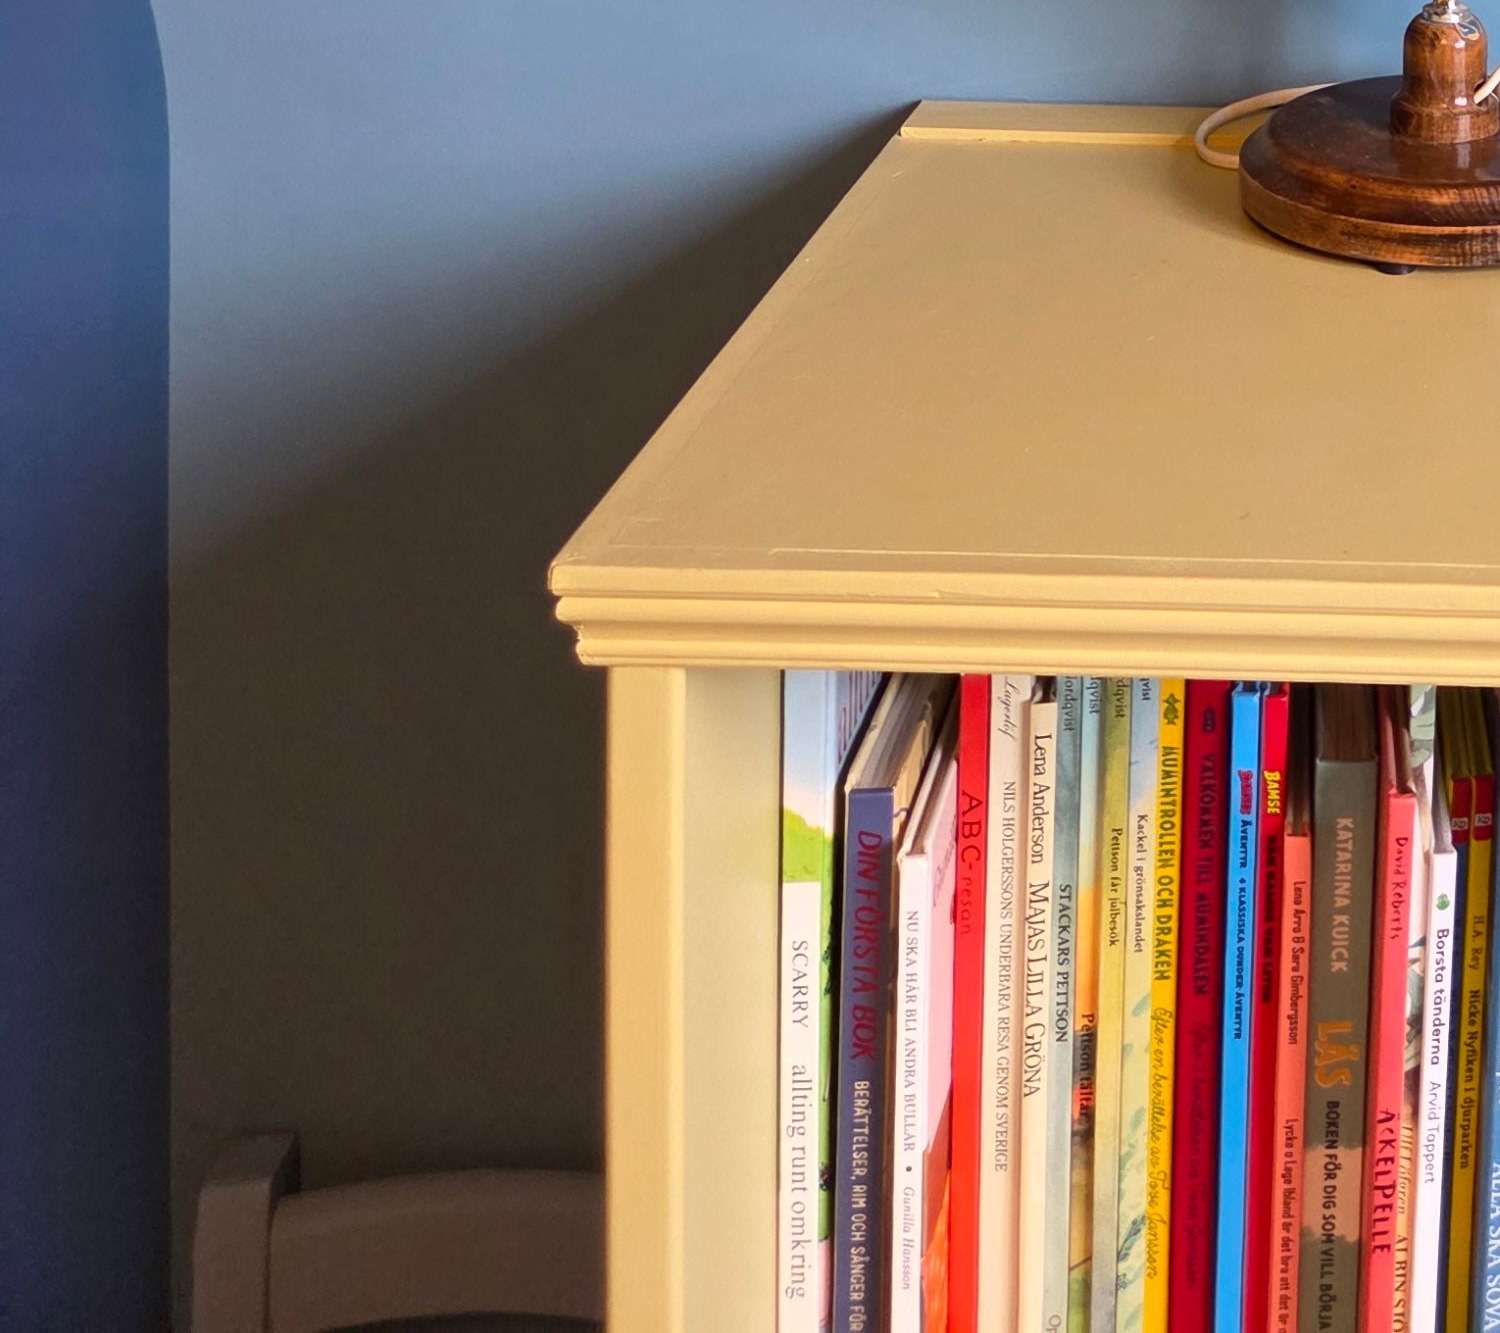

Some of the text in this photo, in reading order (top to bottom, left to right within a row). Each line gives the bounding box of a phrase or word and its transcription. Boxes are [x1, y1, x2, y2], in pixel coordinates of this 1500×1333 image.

[1030, 733, 1053, 865] Lena Anderson
[1263, 769, 1282, 815] BAMSE
[856, 830, 883, 879] DIN
[1106, 827, 1126, 948] Pettson julbesök
[1132, 814, 1150, 954] Kackel grönsakslandet
[1153, 746, 1180, 982] MUMINTROLLEN OCH DRAKEN
[1393, 836, 1408, 878] David
[1236, 887, 1247, 944] KLASSISKA
[1291, 880, 1307, 972] Lena Sara
[1330, 817, 1354, 973] KATARINA KUICK
[852, 889, 882, 994] FÖRSTA
[994, 781, 1017, 1173] NILS HOLGERSSONS UNDERBARA RESA GENOM SVERIGE
[1055, 884, 1072, 1043] STACKARS PETTSON
[1023, 881, 1051, 1099] MAJAS LILLA GRÖNA
[1463, 947, 1483, 1083] Rey Nicke Nyfiken
[849, 1004, 879, 1061] BOK
[903, 910, 919, 1152] NU SKA HÄR BLI ANDRA BULLAR
[1078, 1013, 1095, 1076] Pettson
[1423, 928, 1450, 1184] Borsta tänderna Arvid Tappert
[785, 940, 813, 1299] SCARRY allting runt omkring
[1324, 1100, 1340, 1150] BOKEN
[852, 1184, 867, 1208] RIM
[1322, 1185, 1337, 1210] DIG
[1323, 1152, 1342, 1182] FÖR
[851, 1210, 867, 1239] OCH
[902, 1186, 915, 1291] Gunilla Hansson
[1320, 1246, 1335, 1280] VILL
[1321, 1213, 1336, 1244] SOM
[849, 1243, 867, 1300] SÅNGER
[1318, 1283, 1335, 1331] BÖRJA
